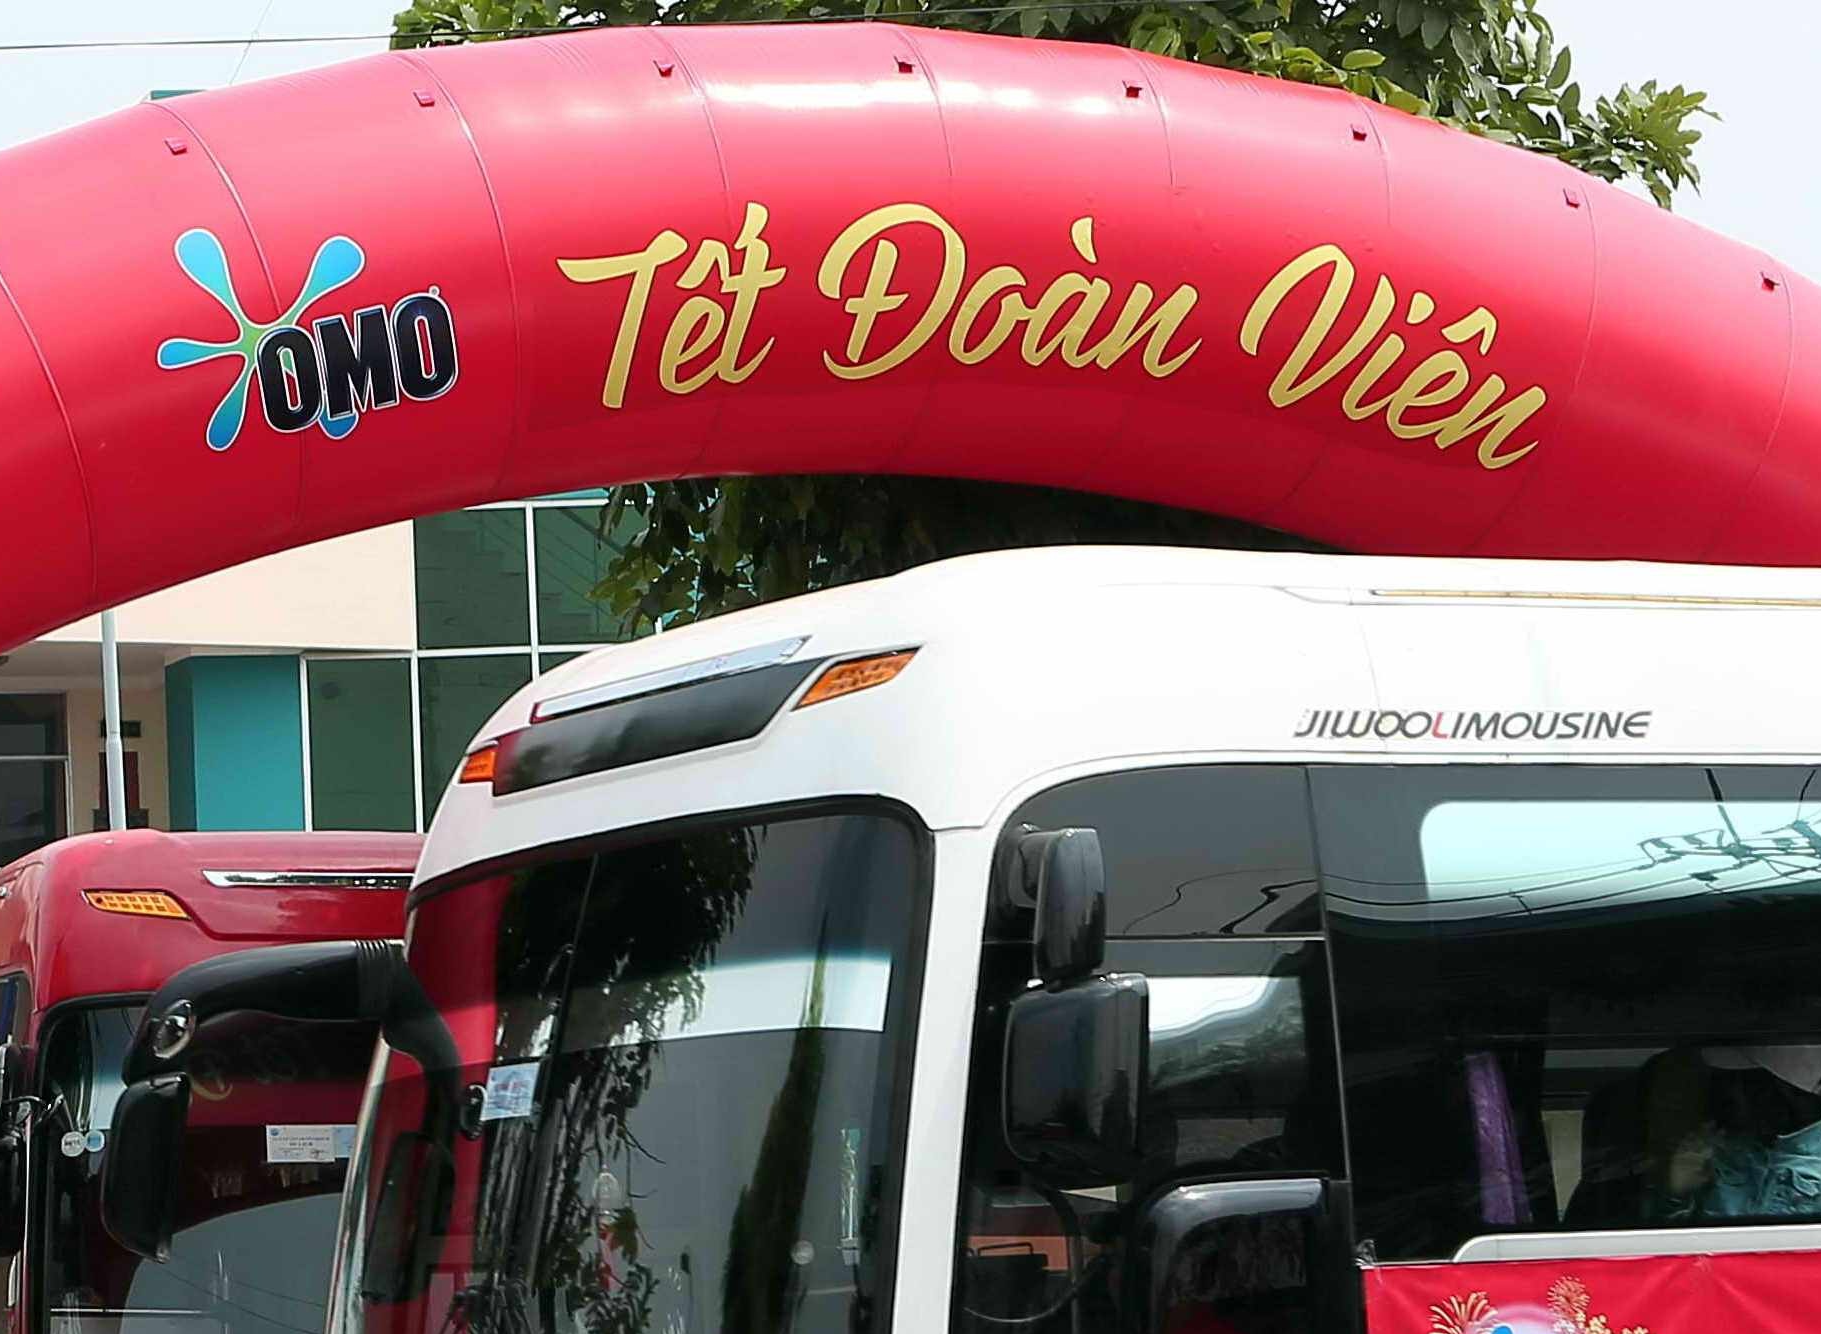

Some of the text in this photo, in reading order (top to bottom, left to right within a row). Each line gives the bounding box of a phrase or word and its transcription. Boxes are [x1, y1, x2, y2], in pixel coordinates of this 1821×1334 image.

[255, 290, 459, 433] OMO
[557, 202, 1549, 470] Tết Đoàn Viên
